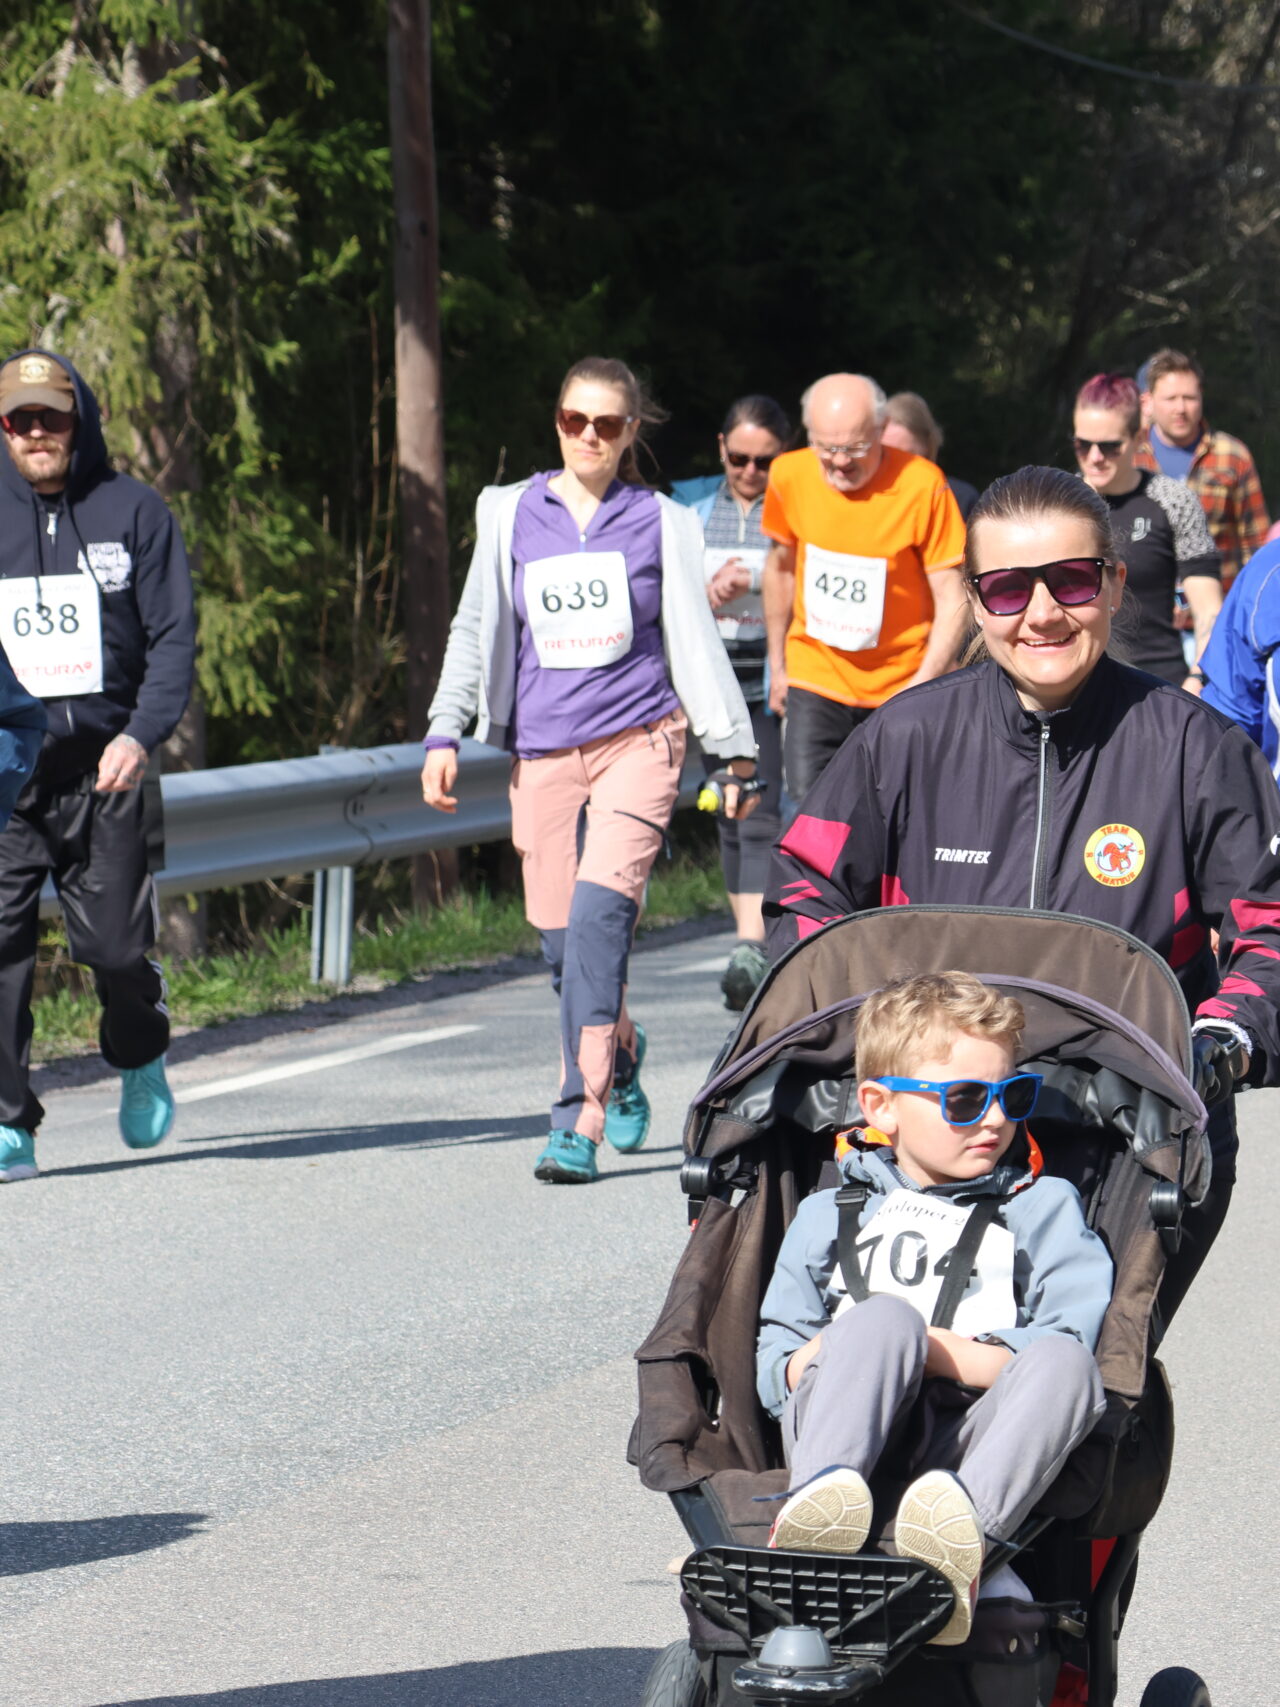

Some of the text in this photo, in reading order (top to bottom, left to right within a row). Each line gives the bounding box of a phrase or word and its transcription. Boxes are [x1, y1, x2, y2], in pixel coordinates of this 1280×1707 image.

[541, 579, 609, 613] 639
[815, 572, 867, 603] 428
[13, 603, 79, 637] 638
[1100, 825, 1130, 835] TEAM
[934, 847, 991, 864] TRIMTEX
[1096, 871, 1136, 885] AMATEUR
